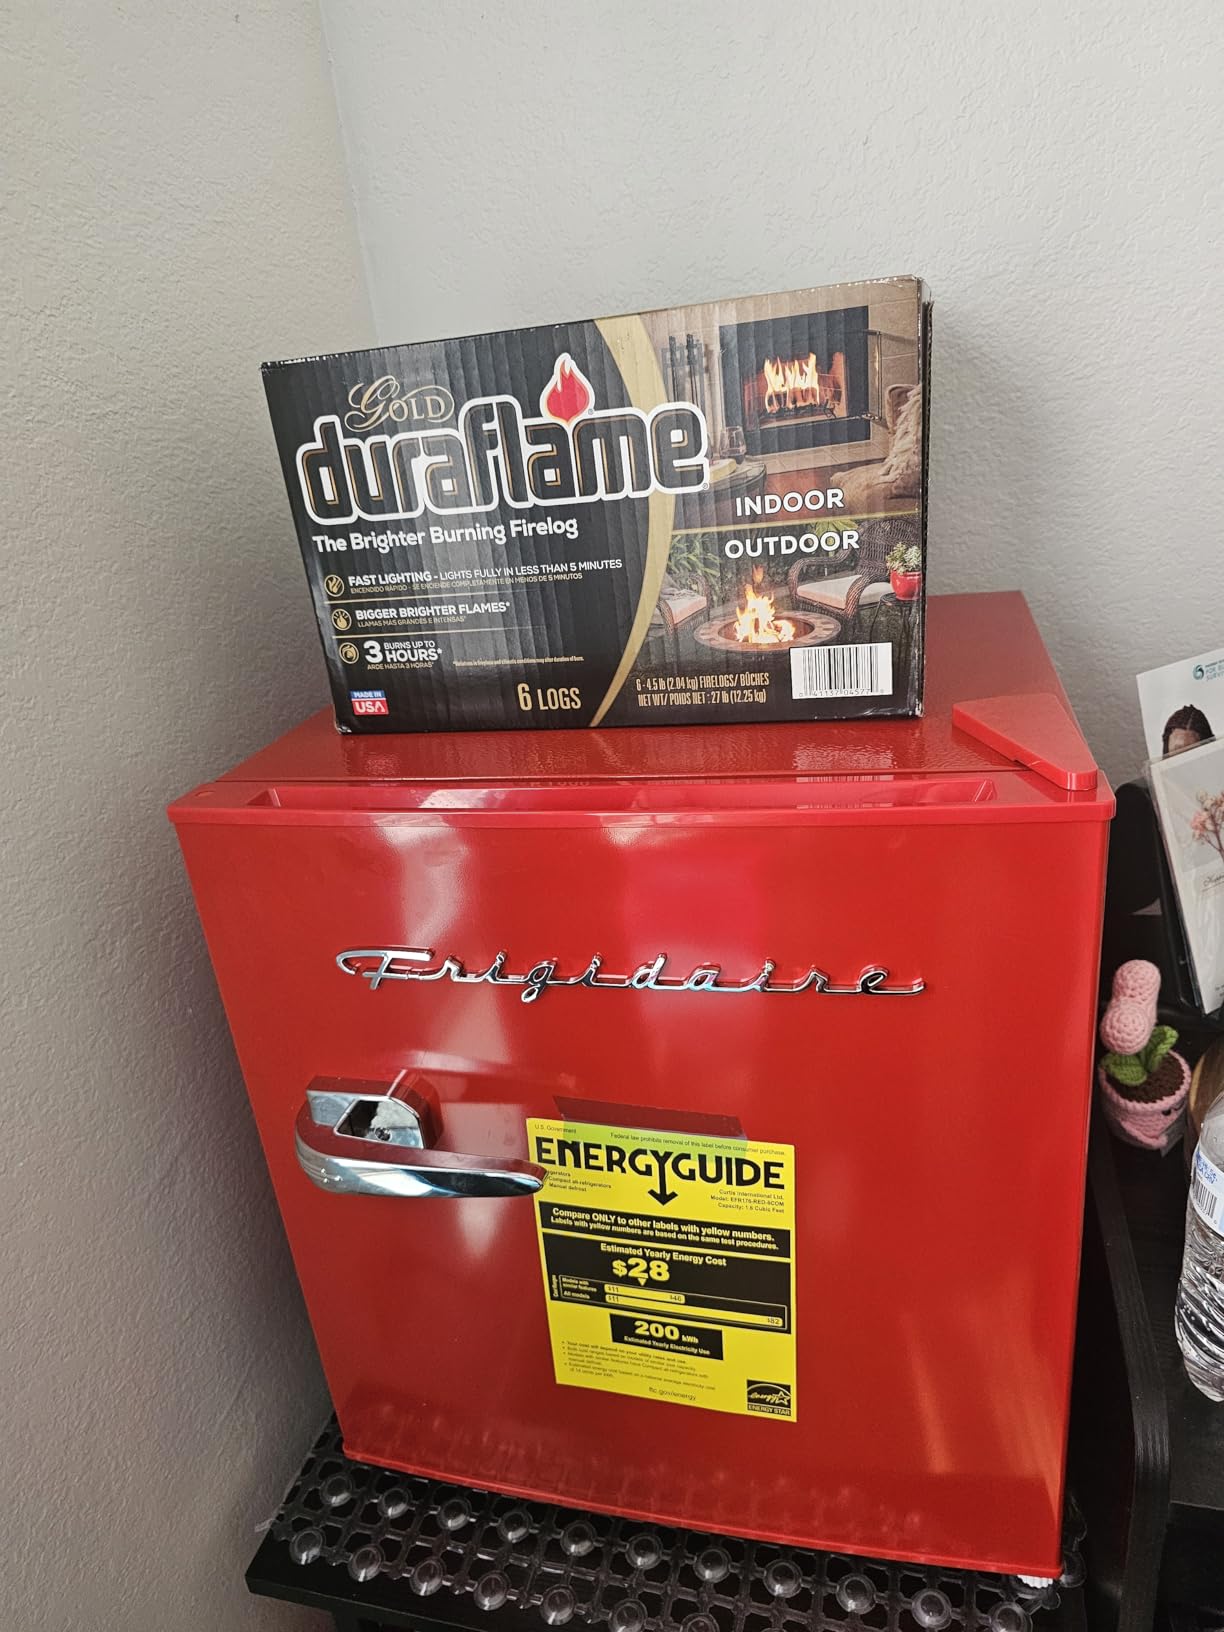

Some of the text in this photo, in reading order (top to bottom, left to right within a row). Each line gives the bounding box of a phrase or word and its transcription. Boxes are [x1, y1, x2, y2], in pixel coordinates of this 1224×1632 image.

[296, 395, 710, 525] duraflame
[736, 488, 844, 516] INDOOR
[312, 517, 578, 553] The Brighter Burning Firelog
[725, 530, 859, 558] OUTDOOR
[348, 575, 376, 586] FAST
[379, 571, 432, 584] LIGHTING
[440, 570, 472, 580] LIGHTS
[474, 568, 502, 578] FULLY
[503, 567, 514, 576] IN
[515, 565, 540, 575] LESS
[540, 563, 568, 573] THAN
[570, 562, 577, 571] 5
[578, 559, 623, 571] MINUTES
[553, 573, 583, 581] MINUTOS
[355, 608, 398, 621] BIGGER
[399, 605, 456, 618] BRIGHTER
[358, 620, 383, 628] LLAMAS
[398, 617, 428, 626] GRANDES
[363, 640, 383, 663] 3
[384, 640, 435, 650] BURNS UP TO
[646, 678, 658, 690] 4.5
[659, 678, 665, 690] lb
[667, 677, 686, 691] (2.04
[686, 676, 698, 690] kg)
[355, 701, 385, 713] USA
[517, 683, 581, 711] 6 LOGS
[638, 693, 651, 706] NET
[669, 692, 691, 705] POIDS
[692, 691, 706, 704] NET
[711, 691, 721, 704] 27
[722, 690, 729, 703] lb
[730, 689, 753, 704] (12.25
[754, 688, 766, 703] kg)
[336, 948, 925, 1003] Frigidaire
[547, 1125, 577, 1134] Government
[611, 1132, 630, 1140] Federal
[536, 1136, 785, 1204] ENERGYGUIDE
[551, 1216, 573, 1226] Labels
[574, 1218, 588, 1228] with
[589, 1221, 611, 1231] yellow
[612, 1224, 642, 1235] numbers
[655, 1228, 676, 1239] based
[688, 1233, 699, 1242] the
[700, 1236, 720, 1244] same
[721, 1237, 735, 1245] test
[553, 1207, 775, 1241] Compare ONLY to other labels with yellow numbers.
[600, 1243, 727, 1267] Estimated Yearly Energy Cost
[612, 1257, 670, 1282] $28
[634, 1320, 680, 1341] 200
[749, 1403, 790, 1415] ENERGY STAR
